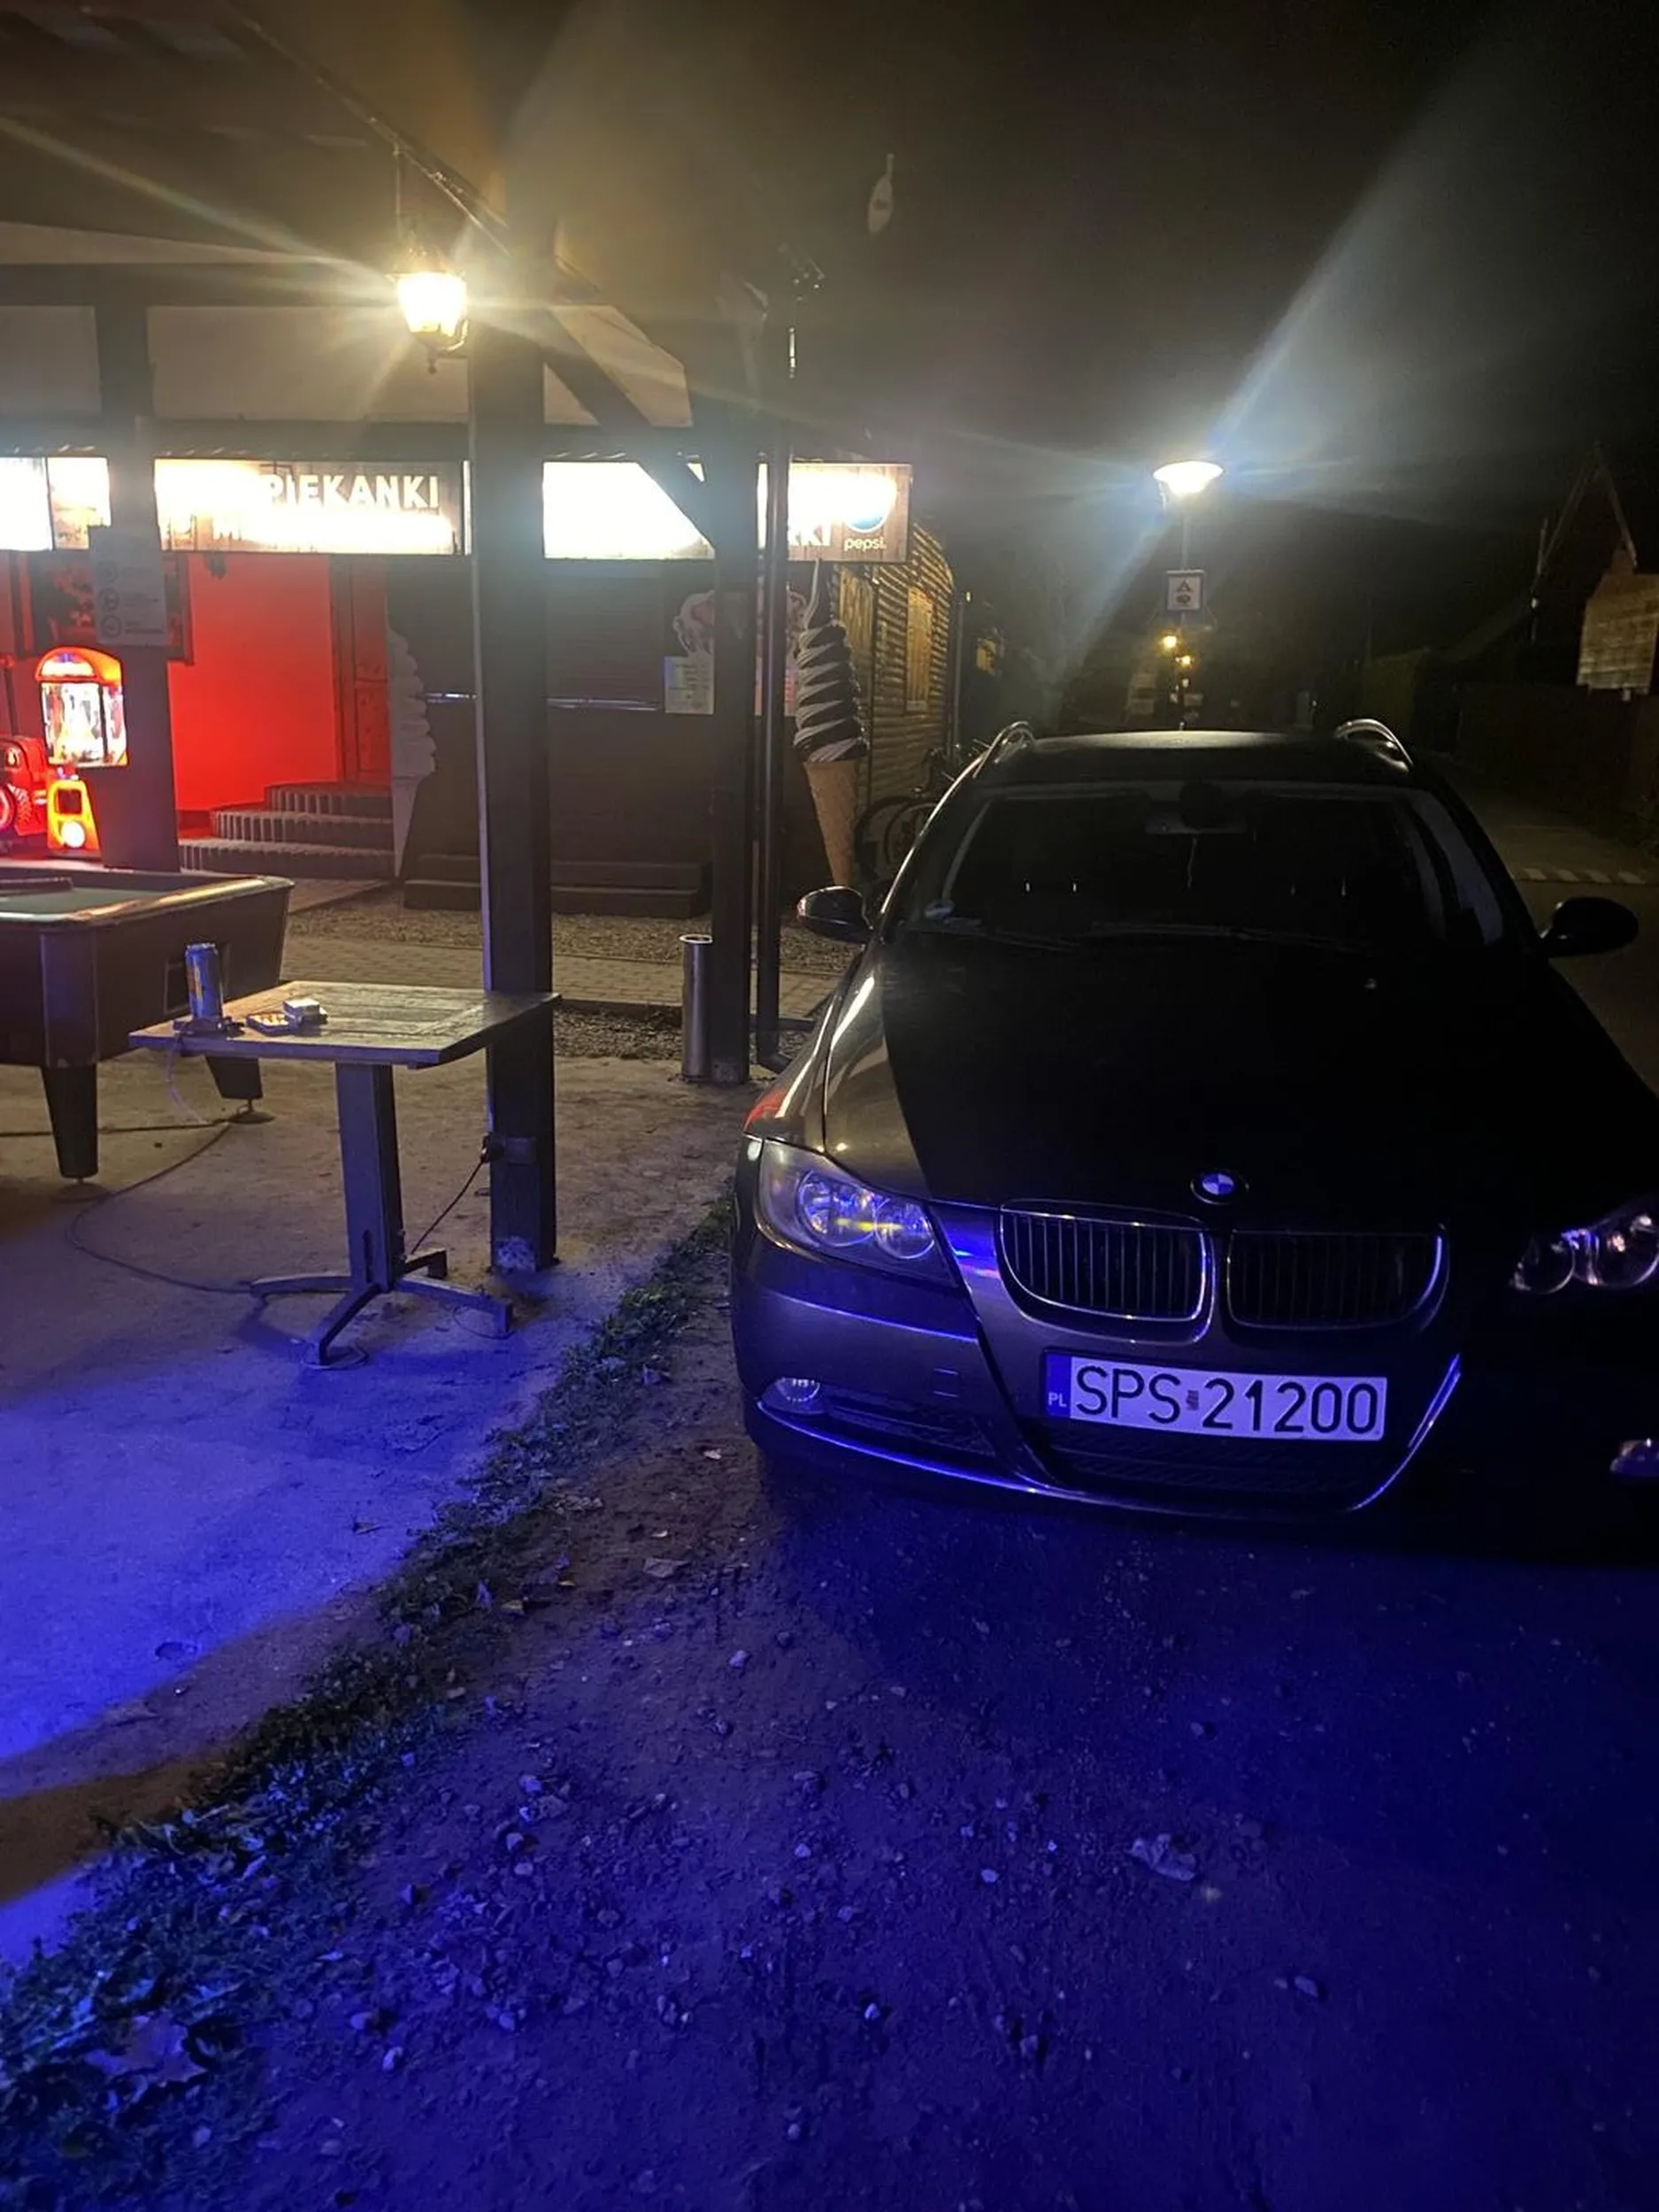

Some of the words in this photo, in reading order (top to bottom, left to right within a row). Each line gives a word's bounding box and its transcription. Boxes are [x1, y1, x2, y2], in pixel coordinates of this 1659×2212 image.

[844, 536, 886, 552] pepsi
[1048, 1391, 1067, 1408] PL
[1076, 1365, 1181, 1425] SPS
[1202, 1378, 1379, 1434] 21200
